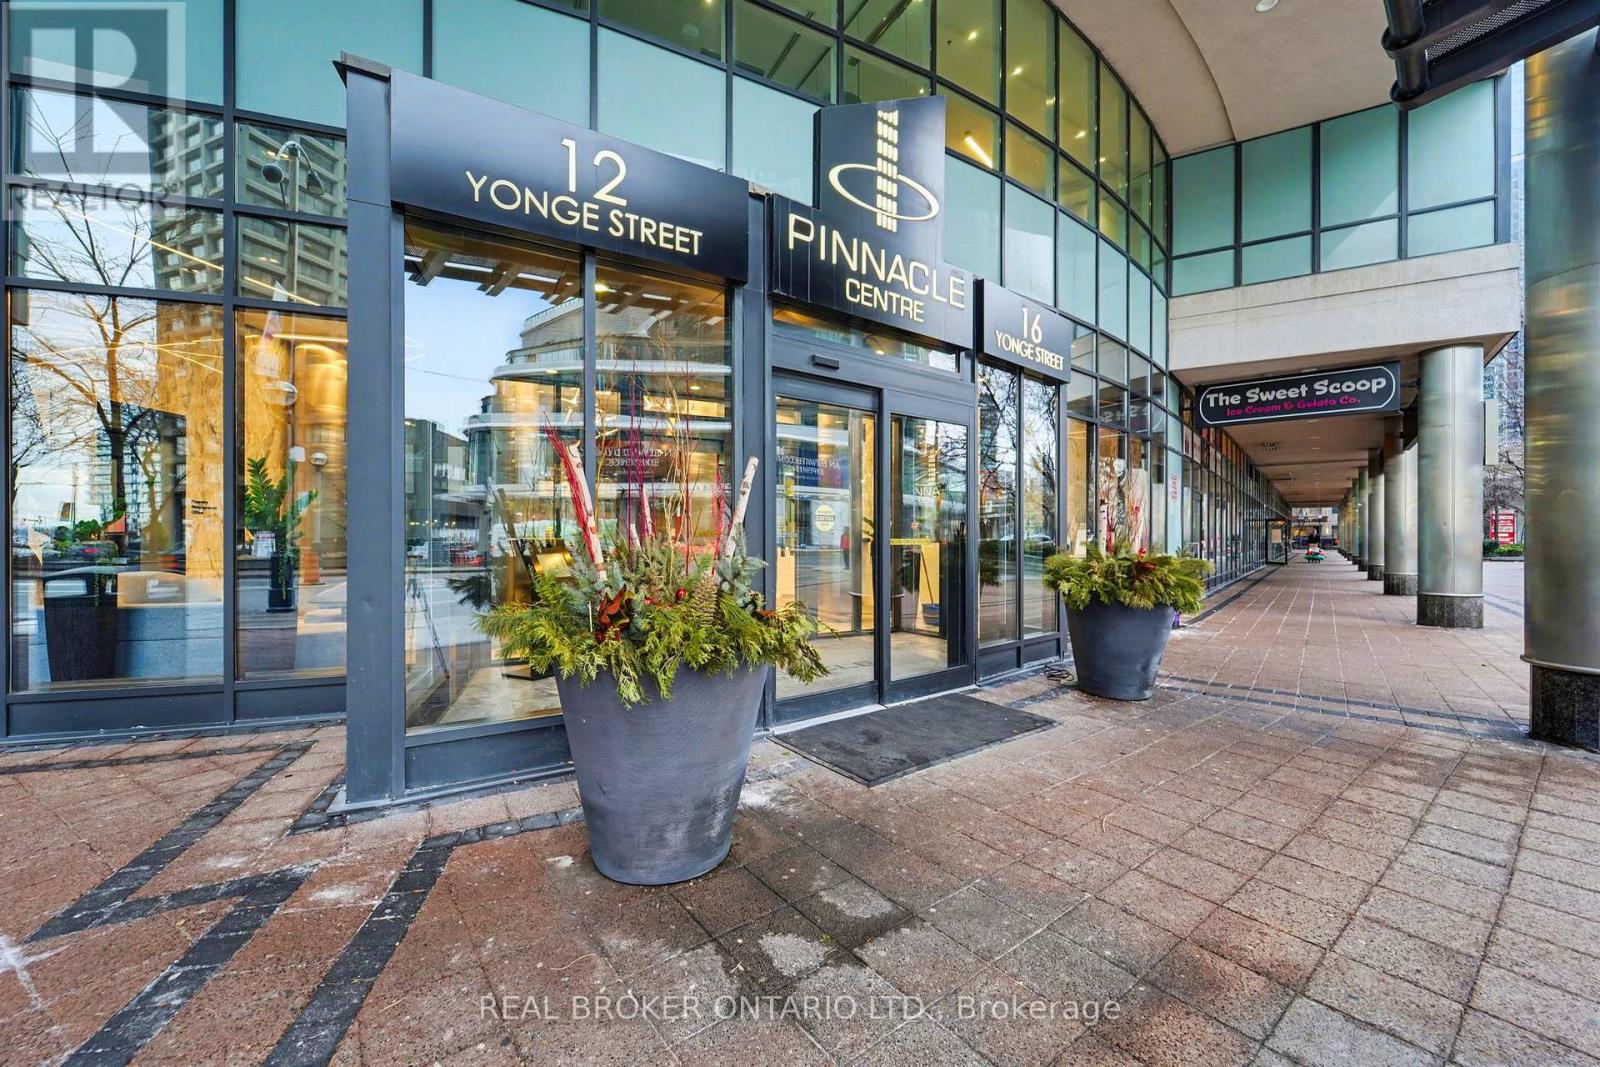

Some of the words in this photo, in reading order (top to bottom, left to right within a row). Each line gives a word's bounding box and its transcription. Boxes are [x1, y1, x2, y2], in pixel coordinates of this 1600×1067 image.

[561, 138, 627, 207] 12
[465, 170, 600, 232] YONGE
[608, 209, 703, 256] STREET
[788, 213, 966, 310] PINNACLE
[845, 277, 925, 323] CENTRE
[1022, 307, 1043, 344] 16
[995, 329, 1034, 361] YONGE
[1034, 346, 1065, 371] STREET
[1206, 392, 1242, 407] The
[1246, 383, 1308, 403] Sweet
[1313, 377, 1387, 396] Scoop
[1226, 408, 1243, 417] Ice
[1244, 403, 1281, 414] Cream
[1296, 399, 1337, 410] Gelato
[1339, 394, 1360, 406] Co.
